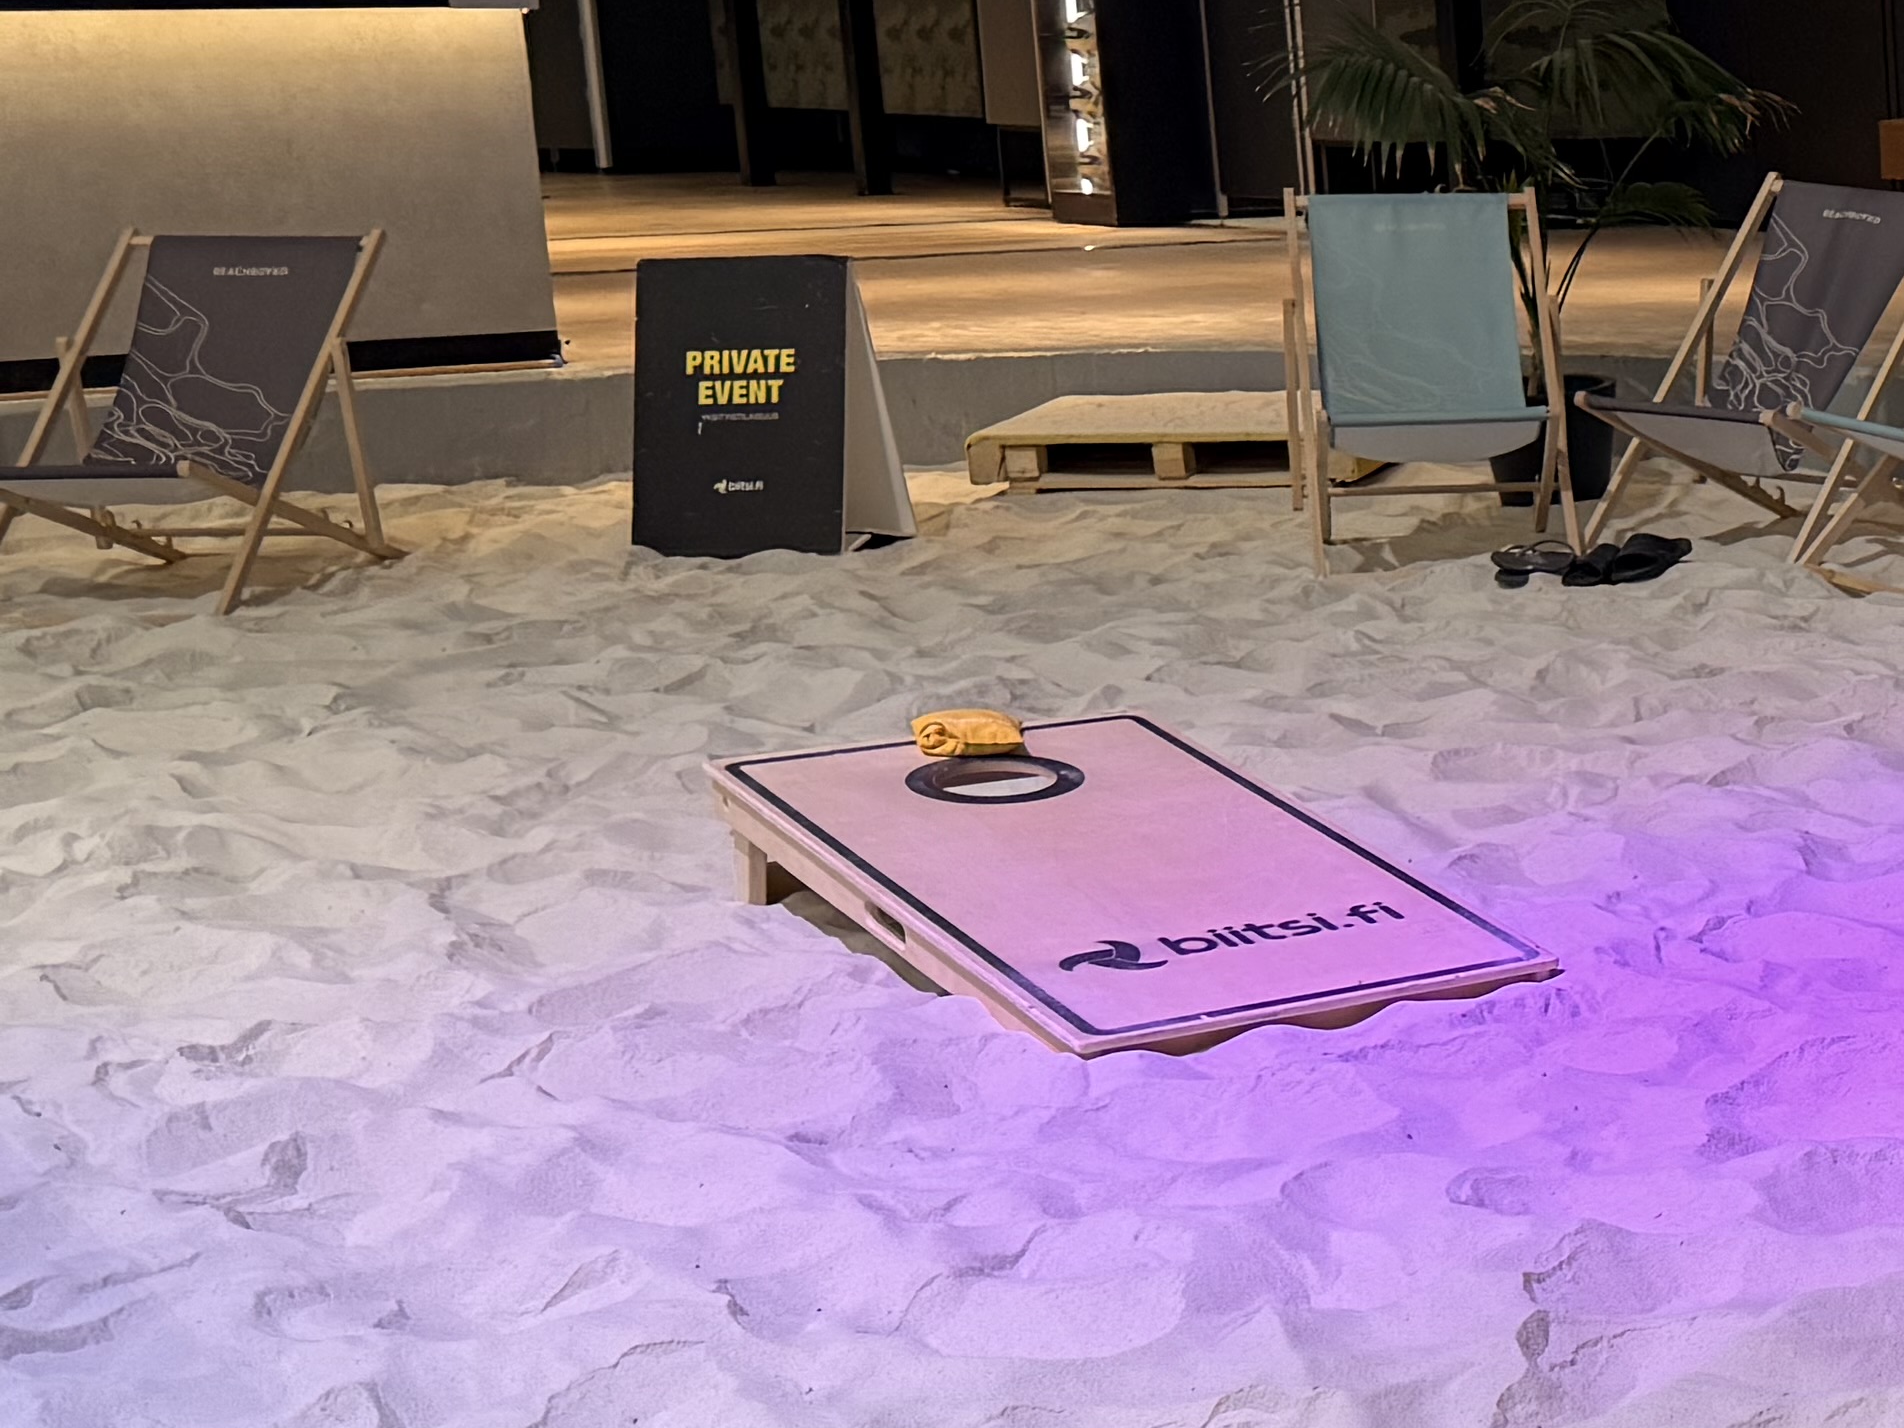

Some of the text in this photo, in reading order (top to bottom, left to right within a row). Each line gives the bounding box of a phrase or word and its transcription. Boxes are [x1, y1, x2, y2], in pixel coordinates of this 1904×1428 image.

[685, 348, 796, 375] PRIVATE
[698, 379, 784, 405] EVENT
[1157, 901, 1405, 956] biitsi.fi
